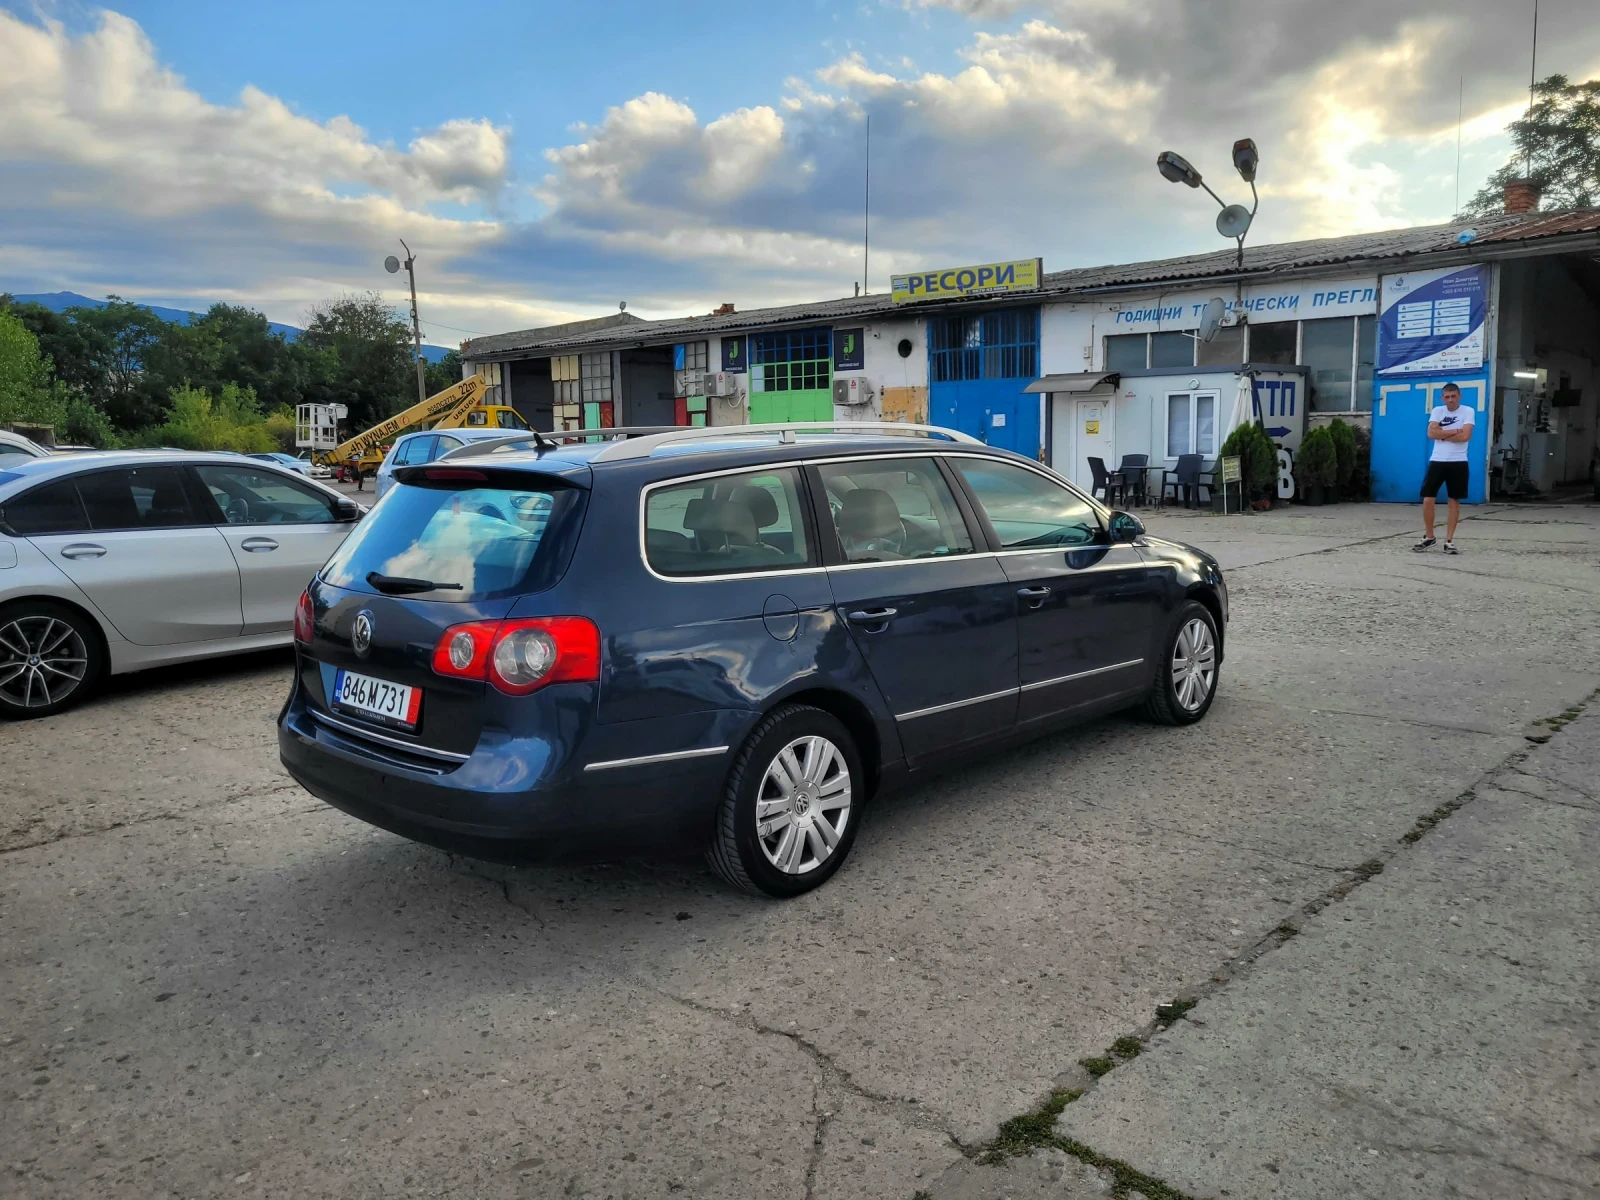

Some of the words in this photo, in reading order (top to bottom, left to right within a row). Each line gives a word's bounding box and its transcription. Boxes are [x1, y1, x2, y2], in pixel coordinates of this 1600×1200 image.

[908, 265, 1015, 294] РЕСОРИ
[1116, 306, 1183, 323] ГОДИШНИ
[1192, 295, 1300, 316] ТНИЧЕСКИ
[458, 381, 477, 397] 22m
[1379, 379, 1487, 416] ГТП
[360, 420, 400, 446] WYNAJEM
